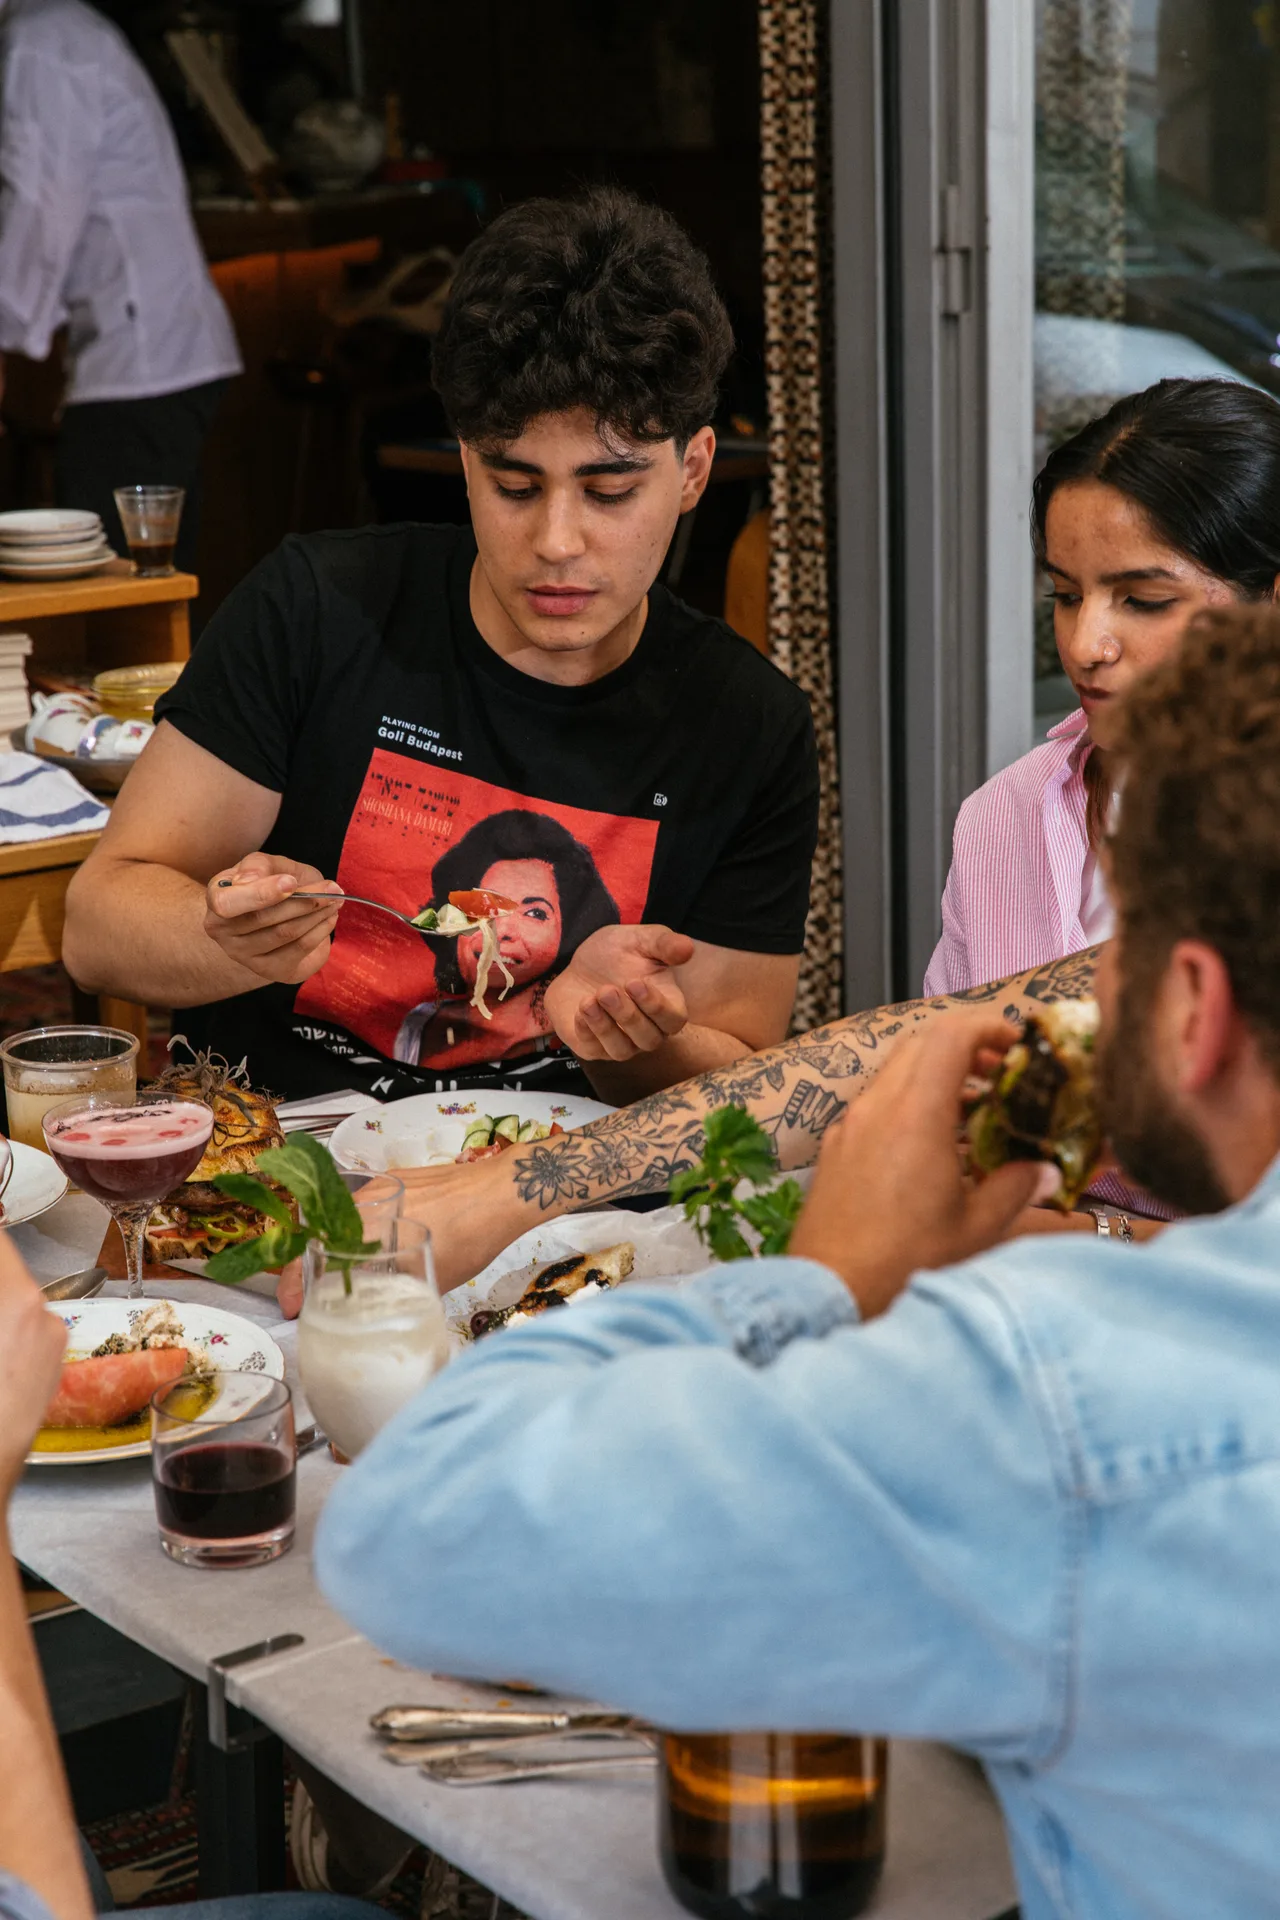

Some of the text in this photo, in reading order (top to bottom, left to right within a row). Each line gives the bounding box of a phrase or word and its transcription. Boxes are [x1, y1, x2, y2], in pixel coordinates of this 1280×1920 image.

[377, 726, 463, 762] Goli Budapest
[381, 715, 440, 739] PLAYING FROM
[362, 797, 412, 825] SHOSHANA
[413, 812, 453, 836] DAMARI
